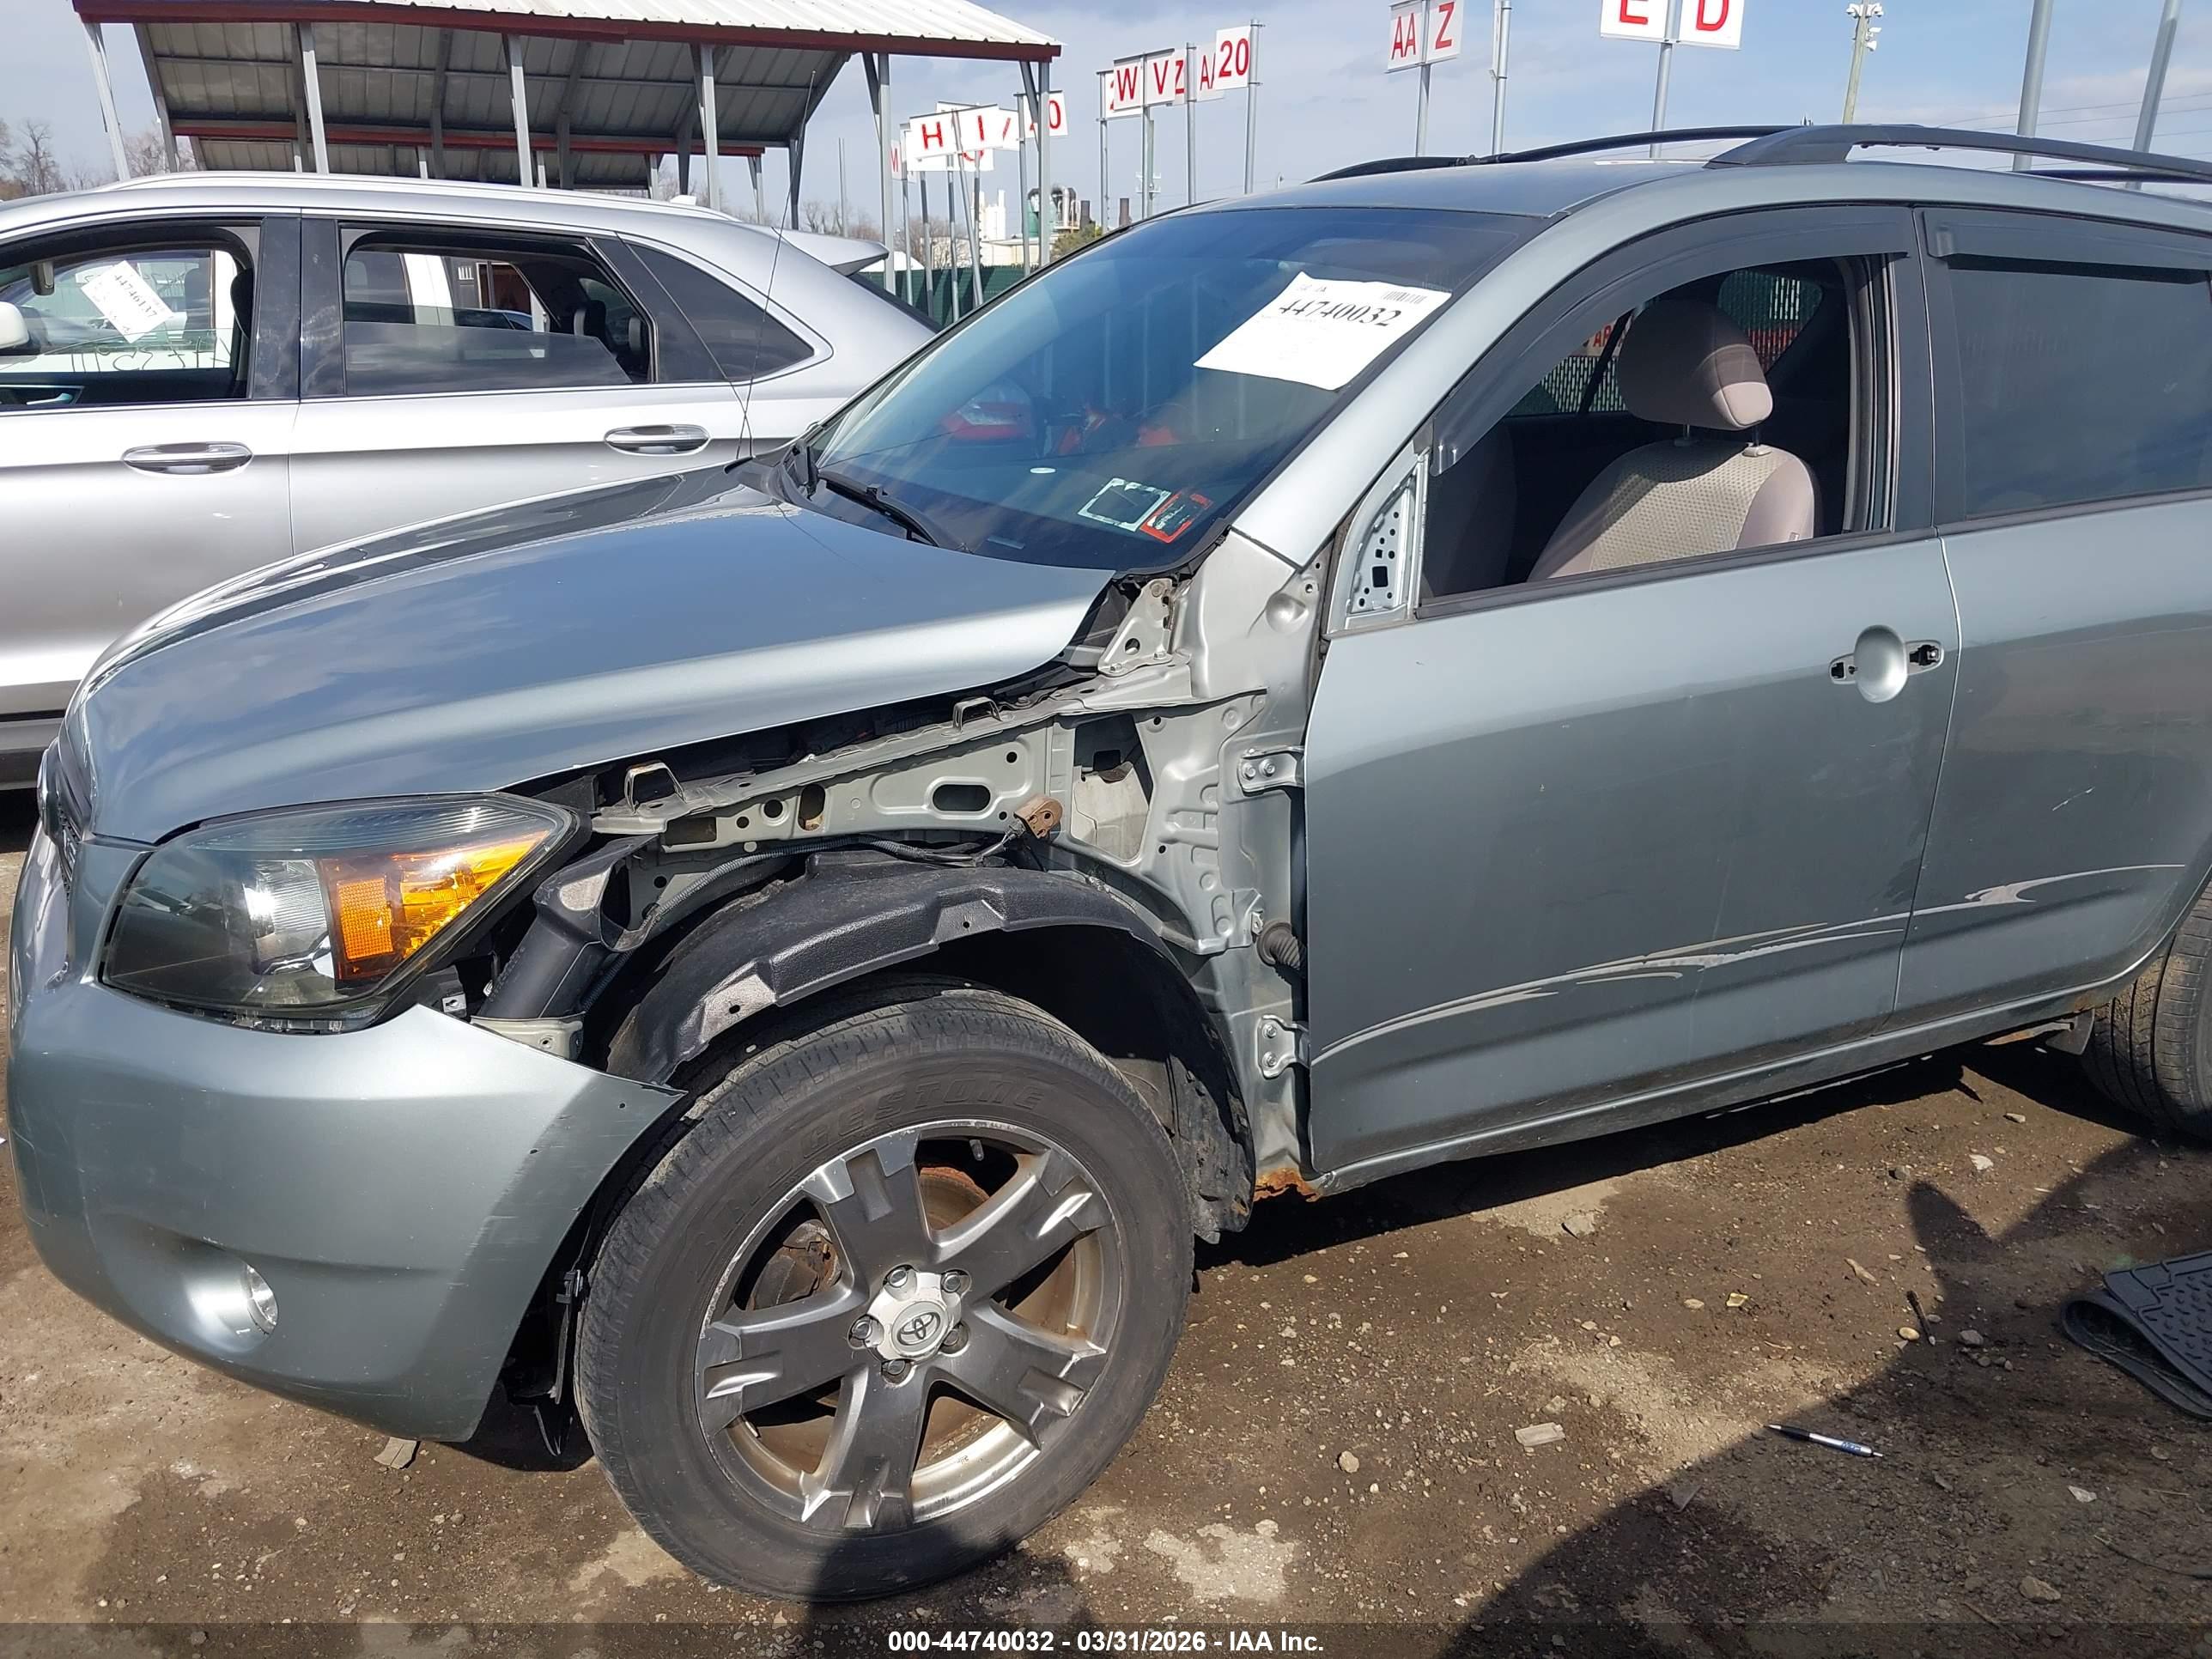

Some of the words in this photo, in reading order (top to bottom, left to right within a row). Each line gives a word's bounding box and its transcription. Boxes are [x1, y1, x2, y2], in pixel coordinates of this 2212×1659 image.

[1391, 13, 1416, 59] AA
[1434, 2, 1455, 50] Z
[1218, 38, 1250, 78] 20
[1116, 66, 1139, 102] W
[1153, 59, 1169, 95] V
[921, 121, 944, 150] H
[977, 115, 985, 142] I
[1279, 298, 1402, 327] 44740032
